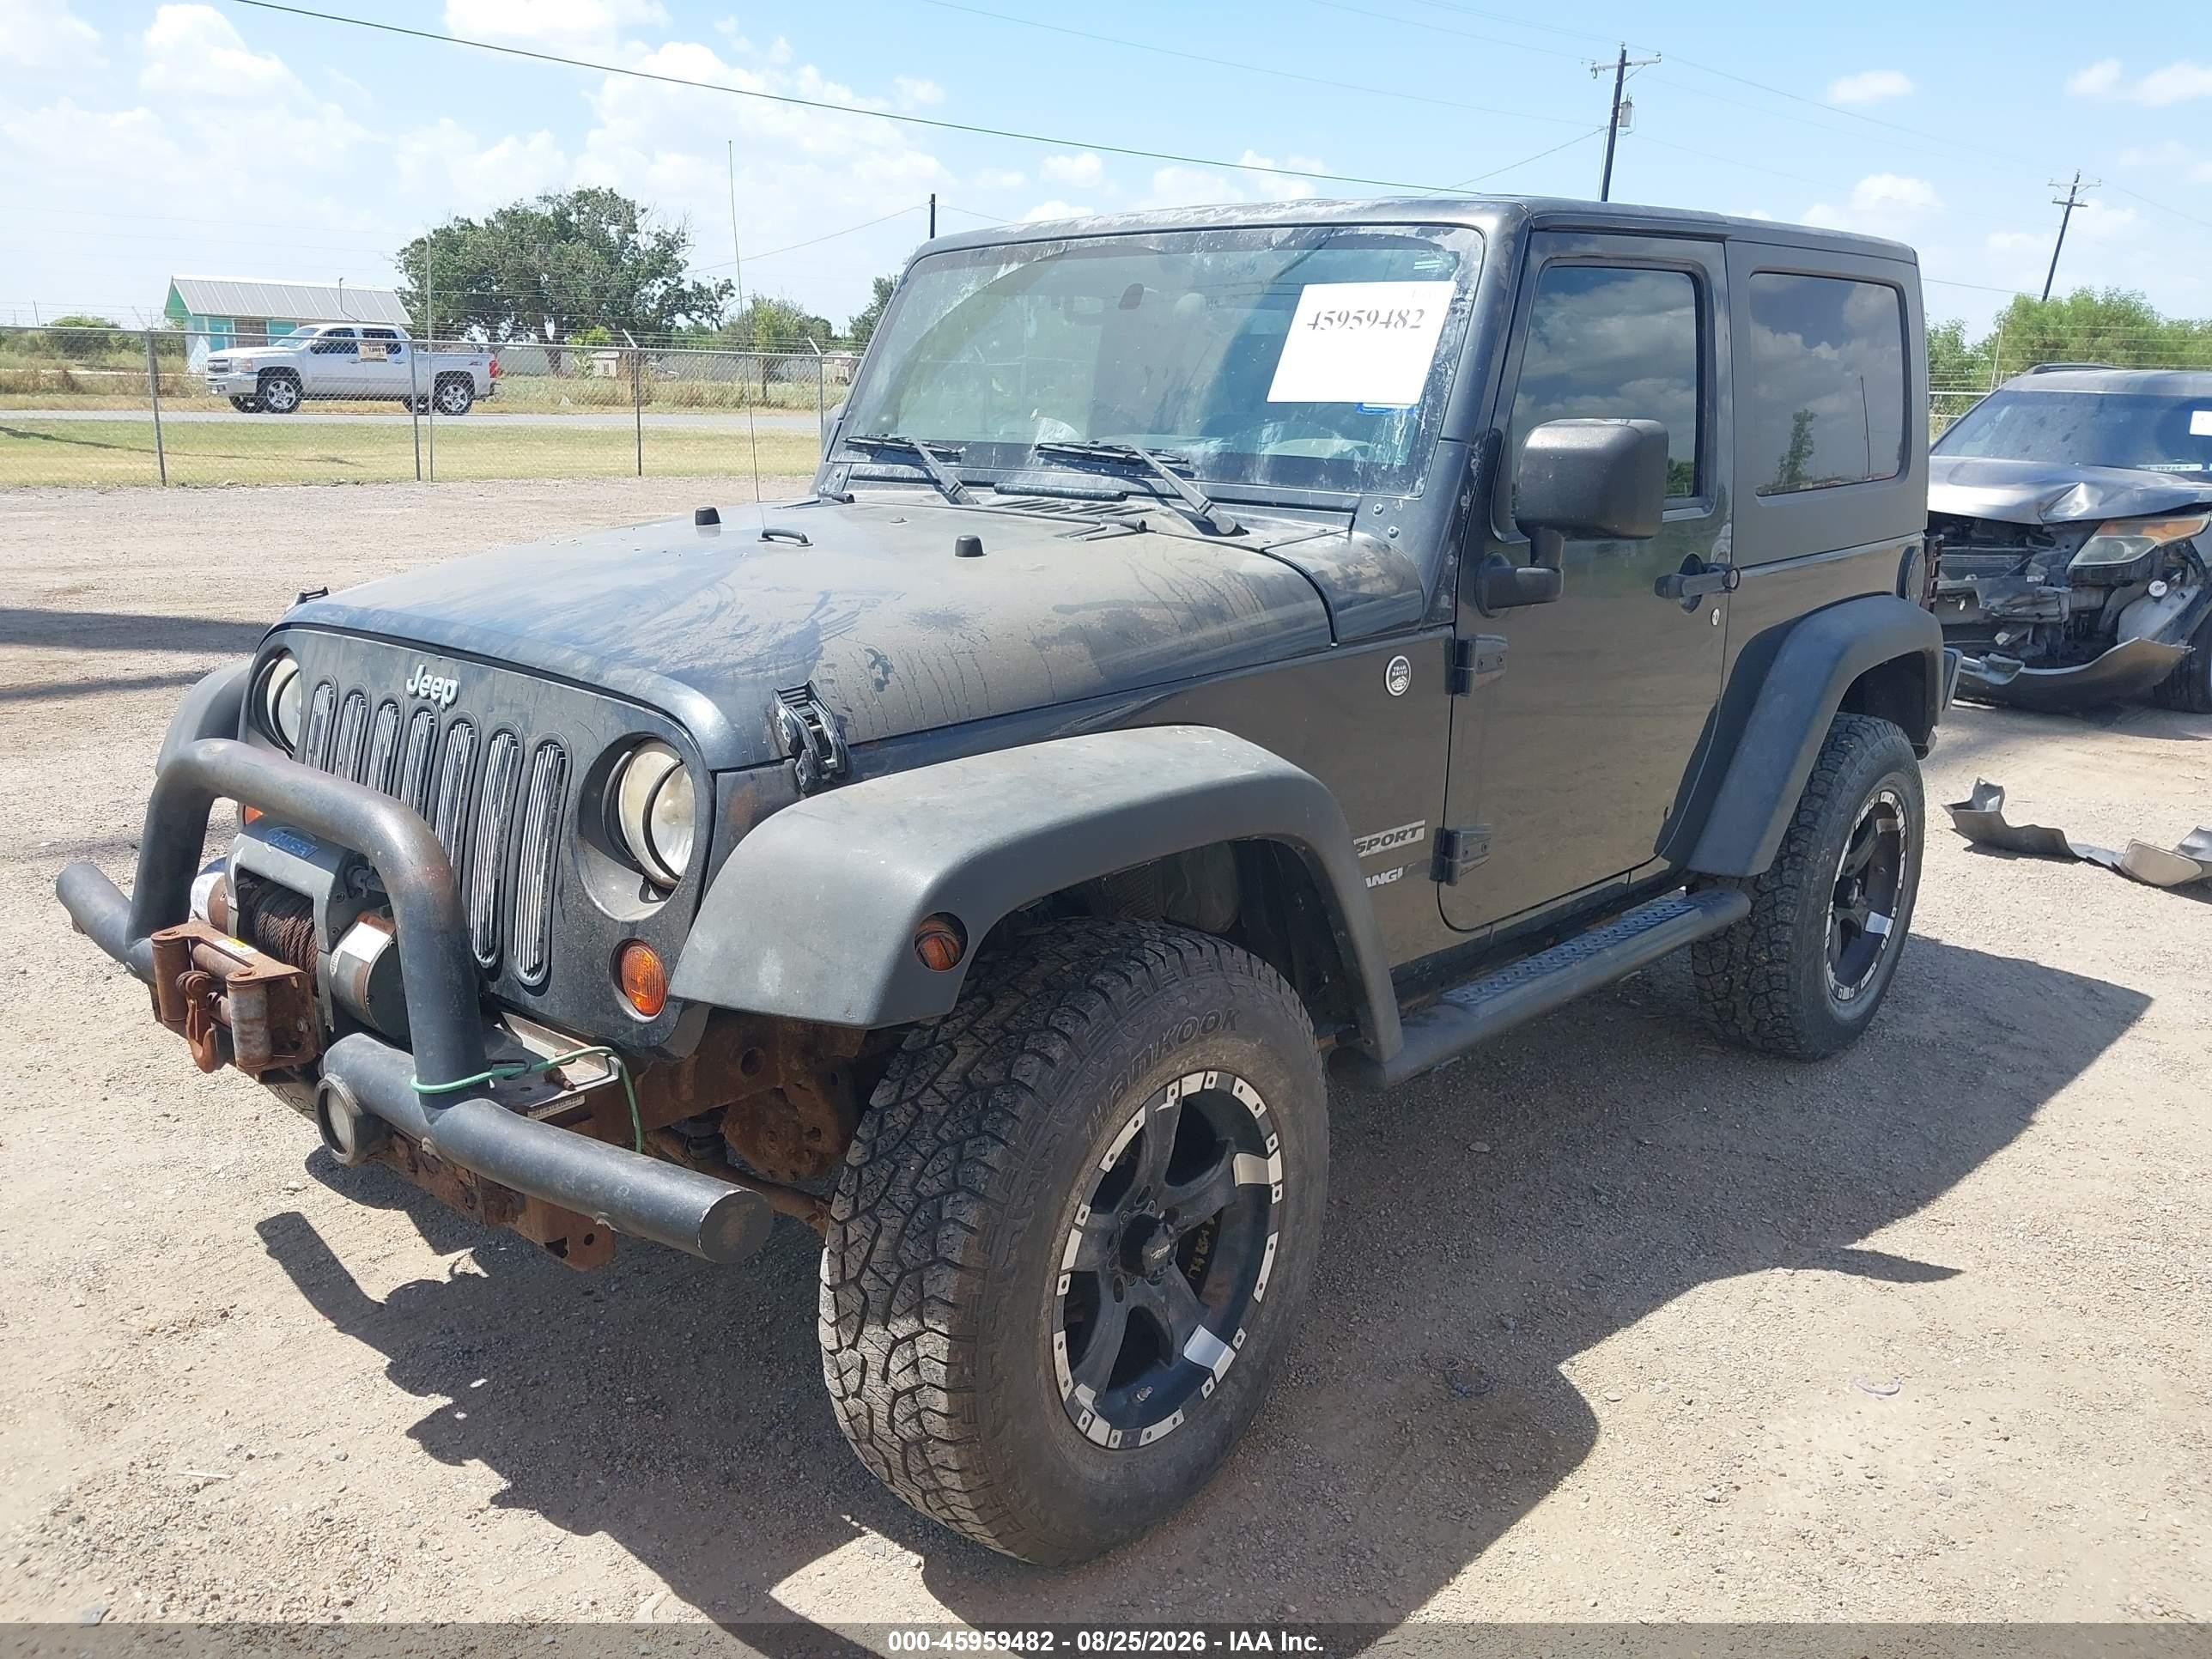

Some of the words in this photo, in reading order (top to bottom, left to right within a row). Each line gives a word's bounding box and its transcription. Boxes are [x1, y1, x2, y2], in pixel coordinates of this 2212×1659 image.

[1306, 308, 1425, 331] 45959482
[406, 664, 459, 709] Jeep
[1354, 824, 1425, 854] SPORT
